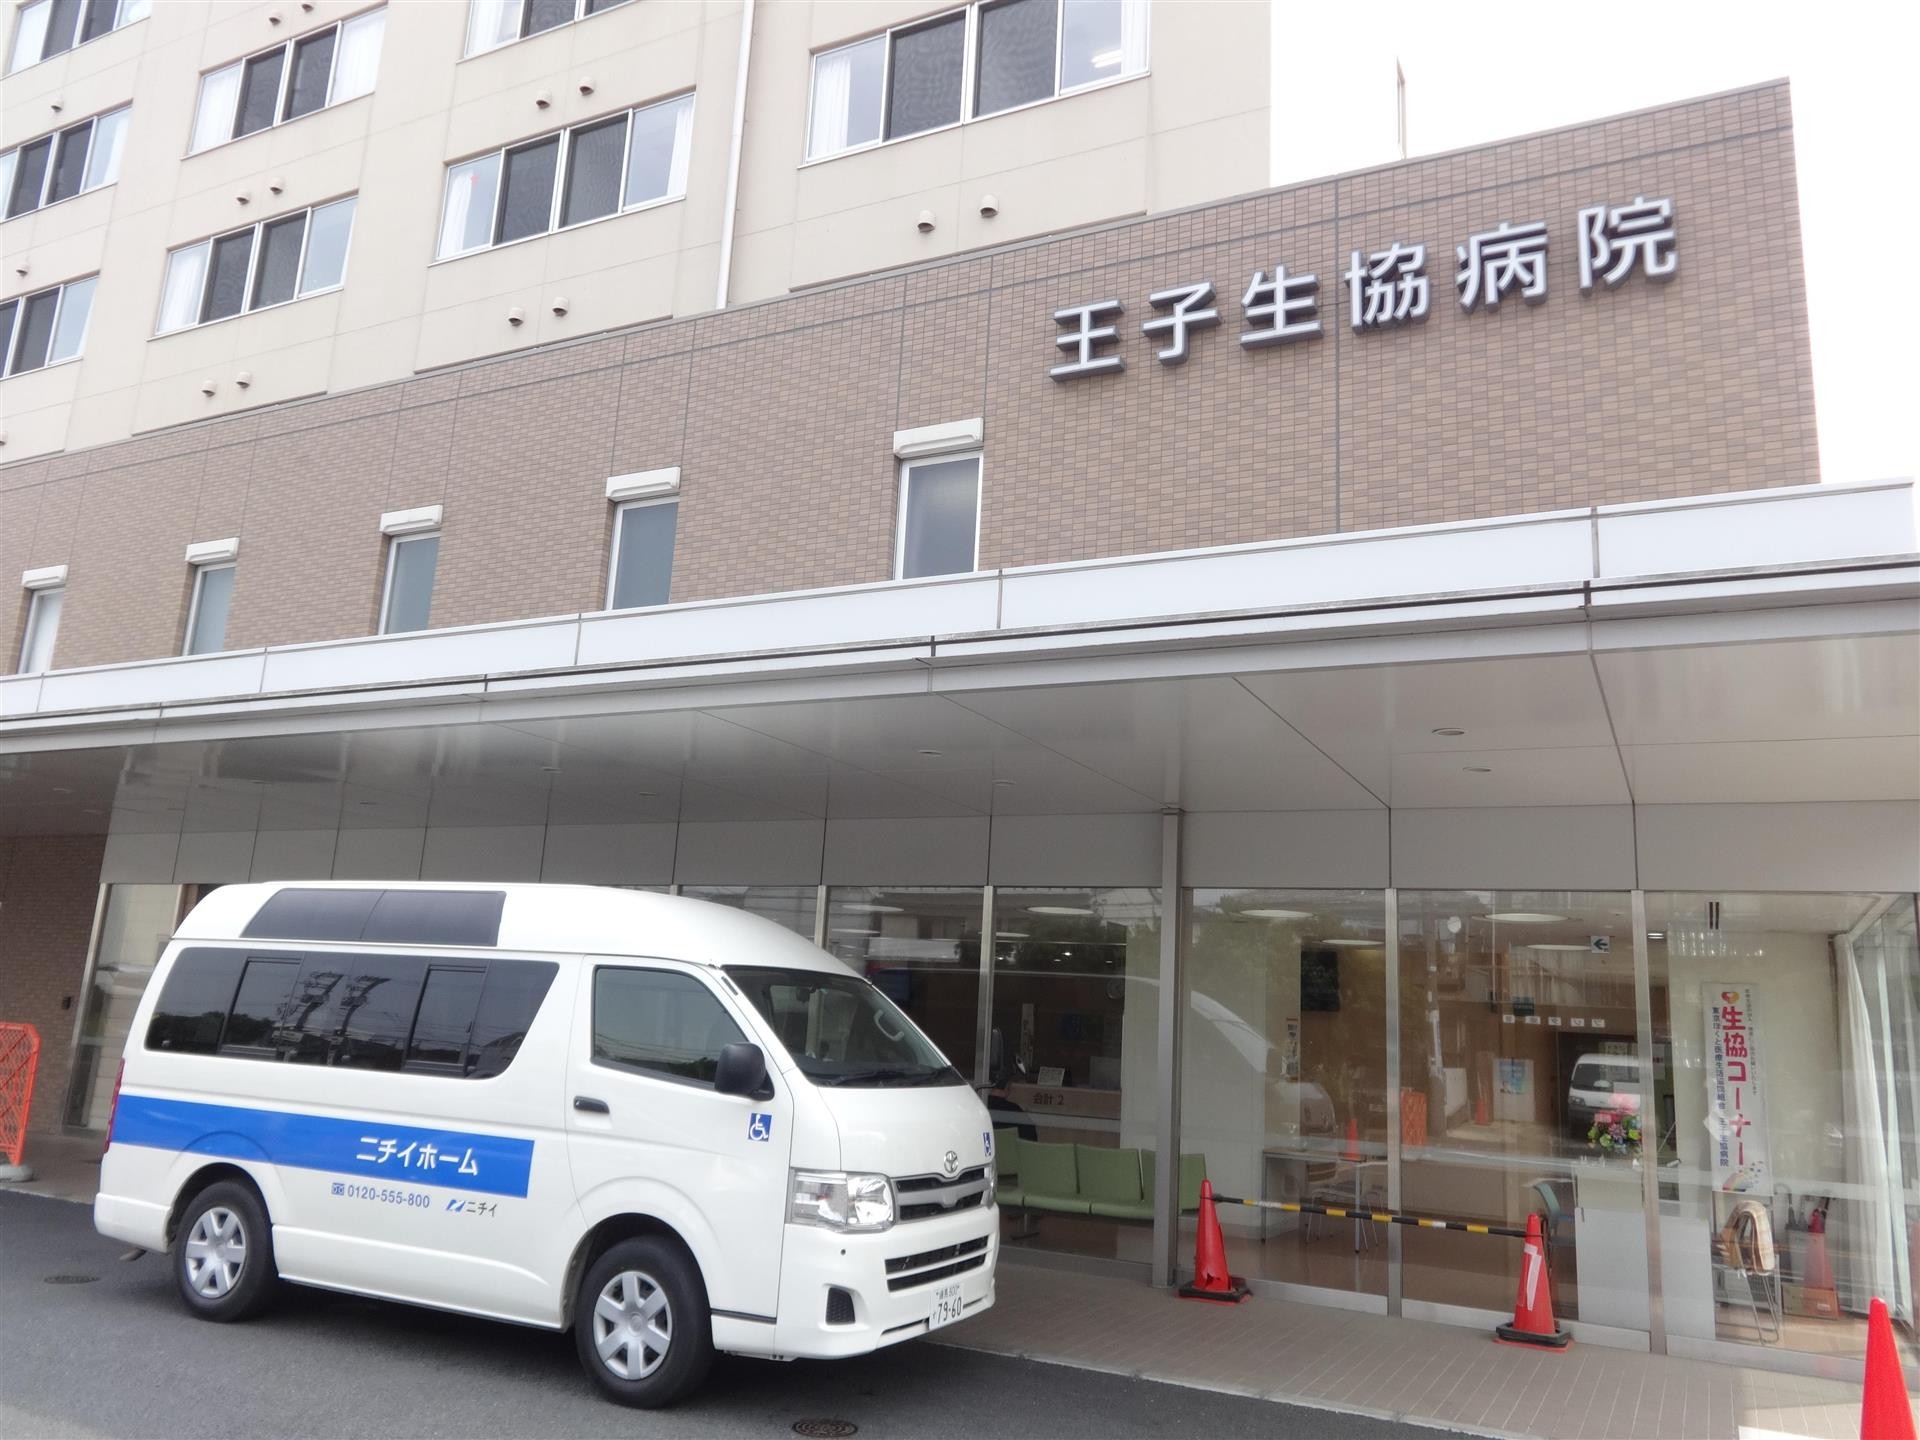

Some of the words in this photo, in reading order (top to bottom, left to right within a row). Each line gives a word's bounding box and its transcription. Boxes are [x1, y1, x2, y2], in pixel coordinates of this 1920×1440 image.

[1048, 196, 1679, 382] 王子生協病院
[1721, 1005, 1751, 1166] 生協コーナー
[356, 1136, 479, 1176] ニチイホーム
[347, 1184, 431, 1209] 0120-555-800
[465, 1201, 498, 1218] ニチイ
